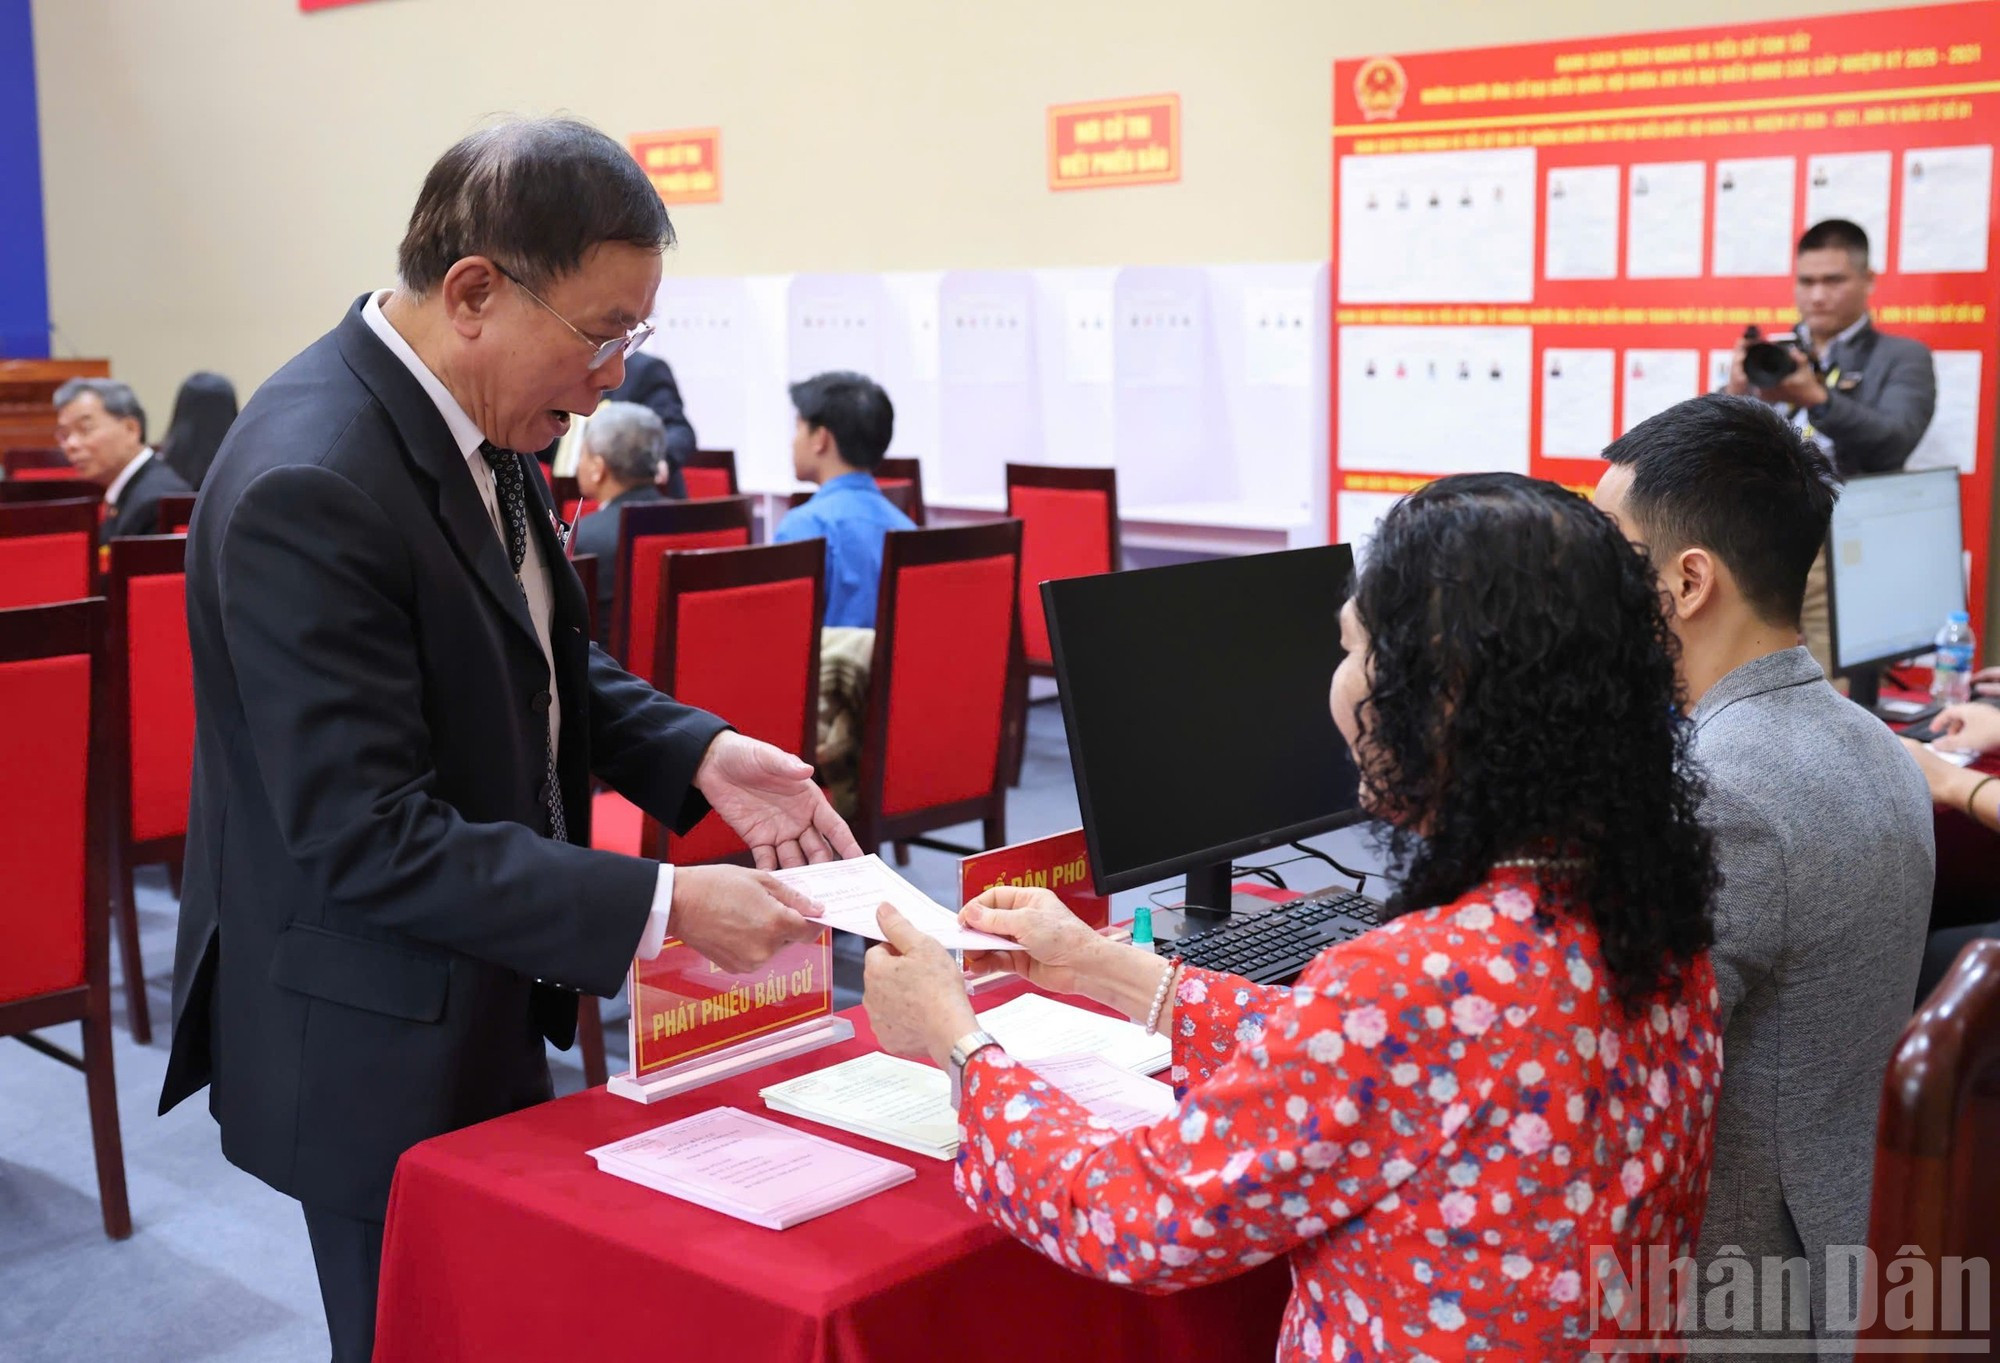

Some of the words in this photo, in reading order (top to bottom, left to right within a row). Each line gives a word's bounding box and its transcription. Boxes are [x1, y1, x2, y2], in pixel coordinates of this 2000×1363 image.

[983, 872, 1006, 891] Ổ
[1053, 851, 1087, 888] PHỐ
[652, 1001, 697, 1041] PHÁT
[701, 981, 750, 1026] PHIẾU
[754, 969, 787, 1009] BẦU
[791, 958, 814, 997] CỬ
